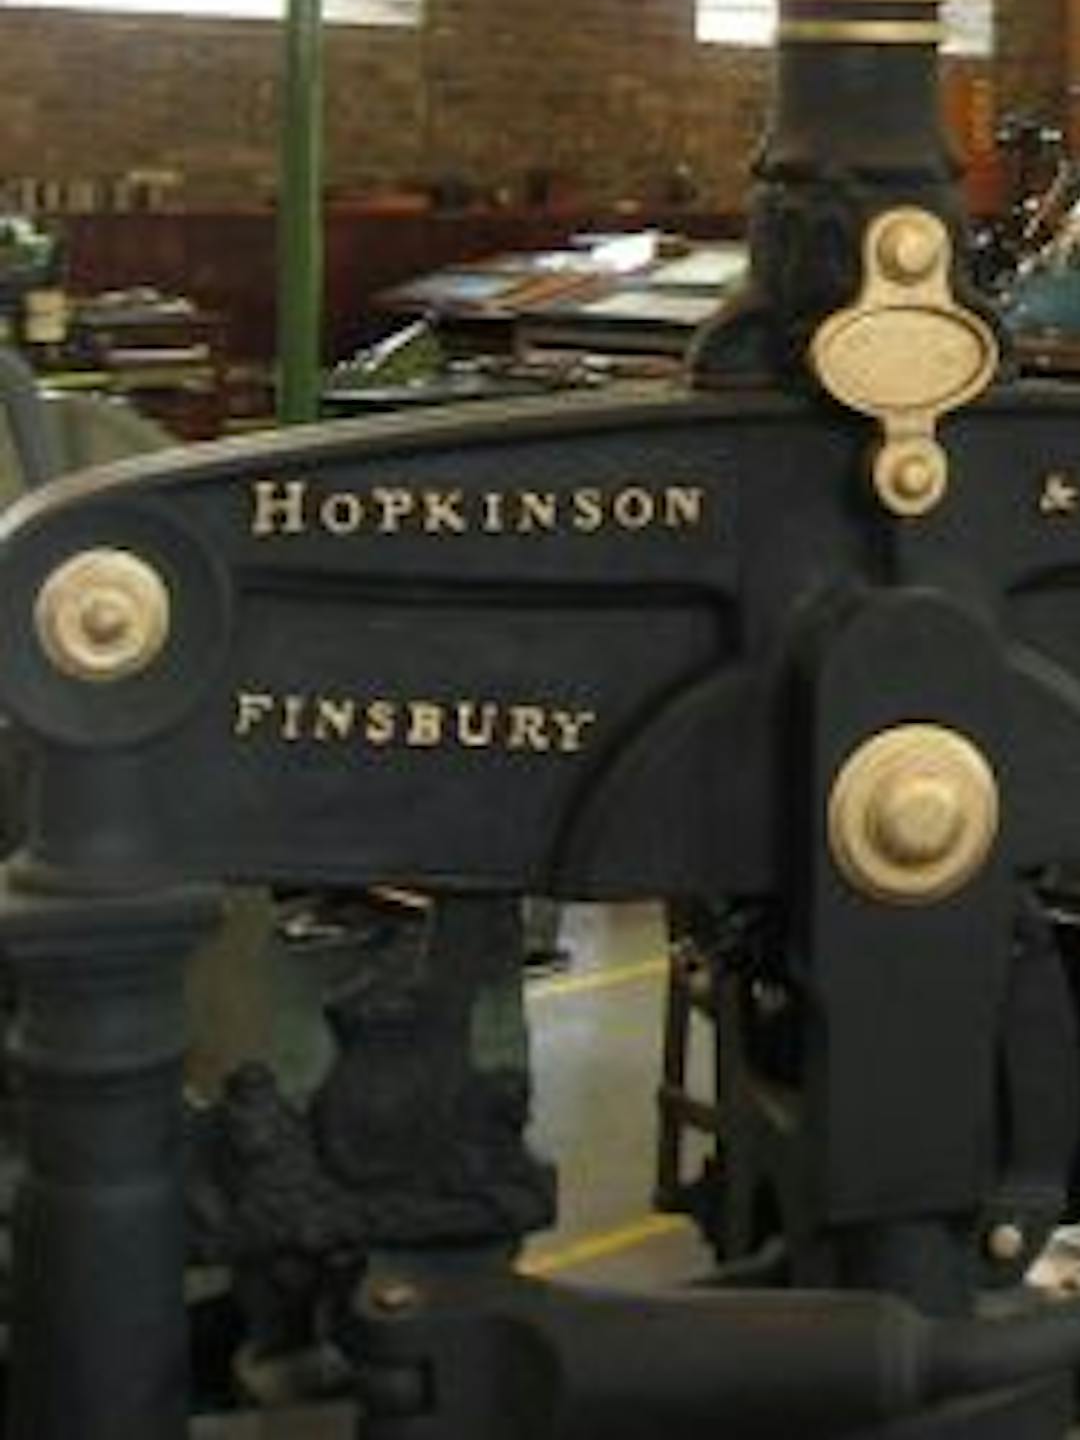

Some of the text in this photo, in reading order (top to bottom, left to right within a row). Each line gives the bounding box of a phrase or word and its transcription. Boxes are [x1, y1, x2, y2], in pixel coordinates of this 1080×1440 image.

[250, 479, 704, 534] HOPKINSON
[1038, 474, 1079, 512] &
[233, 691, 597, 752] FINSBURY
